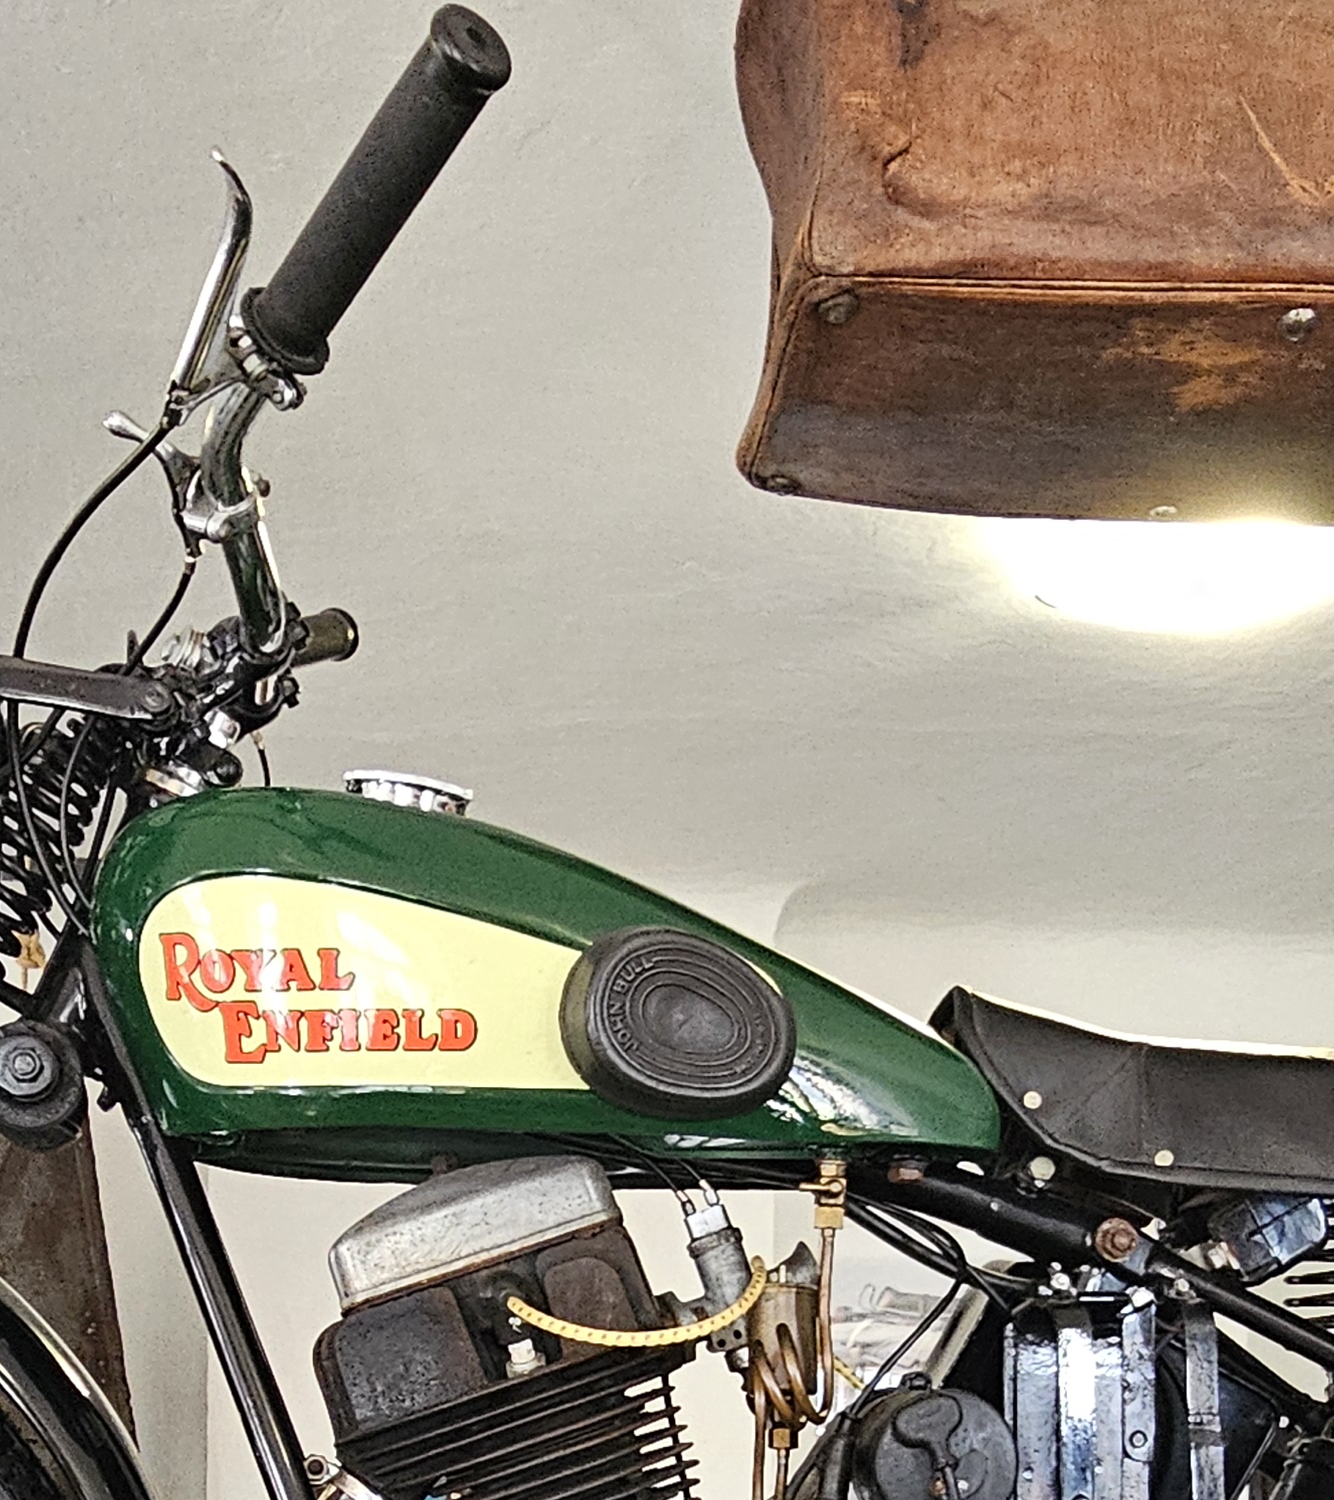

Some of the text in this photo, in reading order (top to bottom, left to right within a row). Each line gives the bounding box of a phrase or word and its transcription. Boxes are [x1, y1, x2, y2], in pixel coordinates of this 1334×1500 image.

[158, 931, 356, 1013] ROYAL
[607, 956, 654, 1052] JOHN BULL
[218, 1000, 478, 1064] ENFIELD
